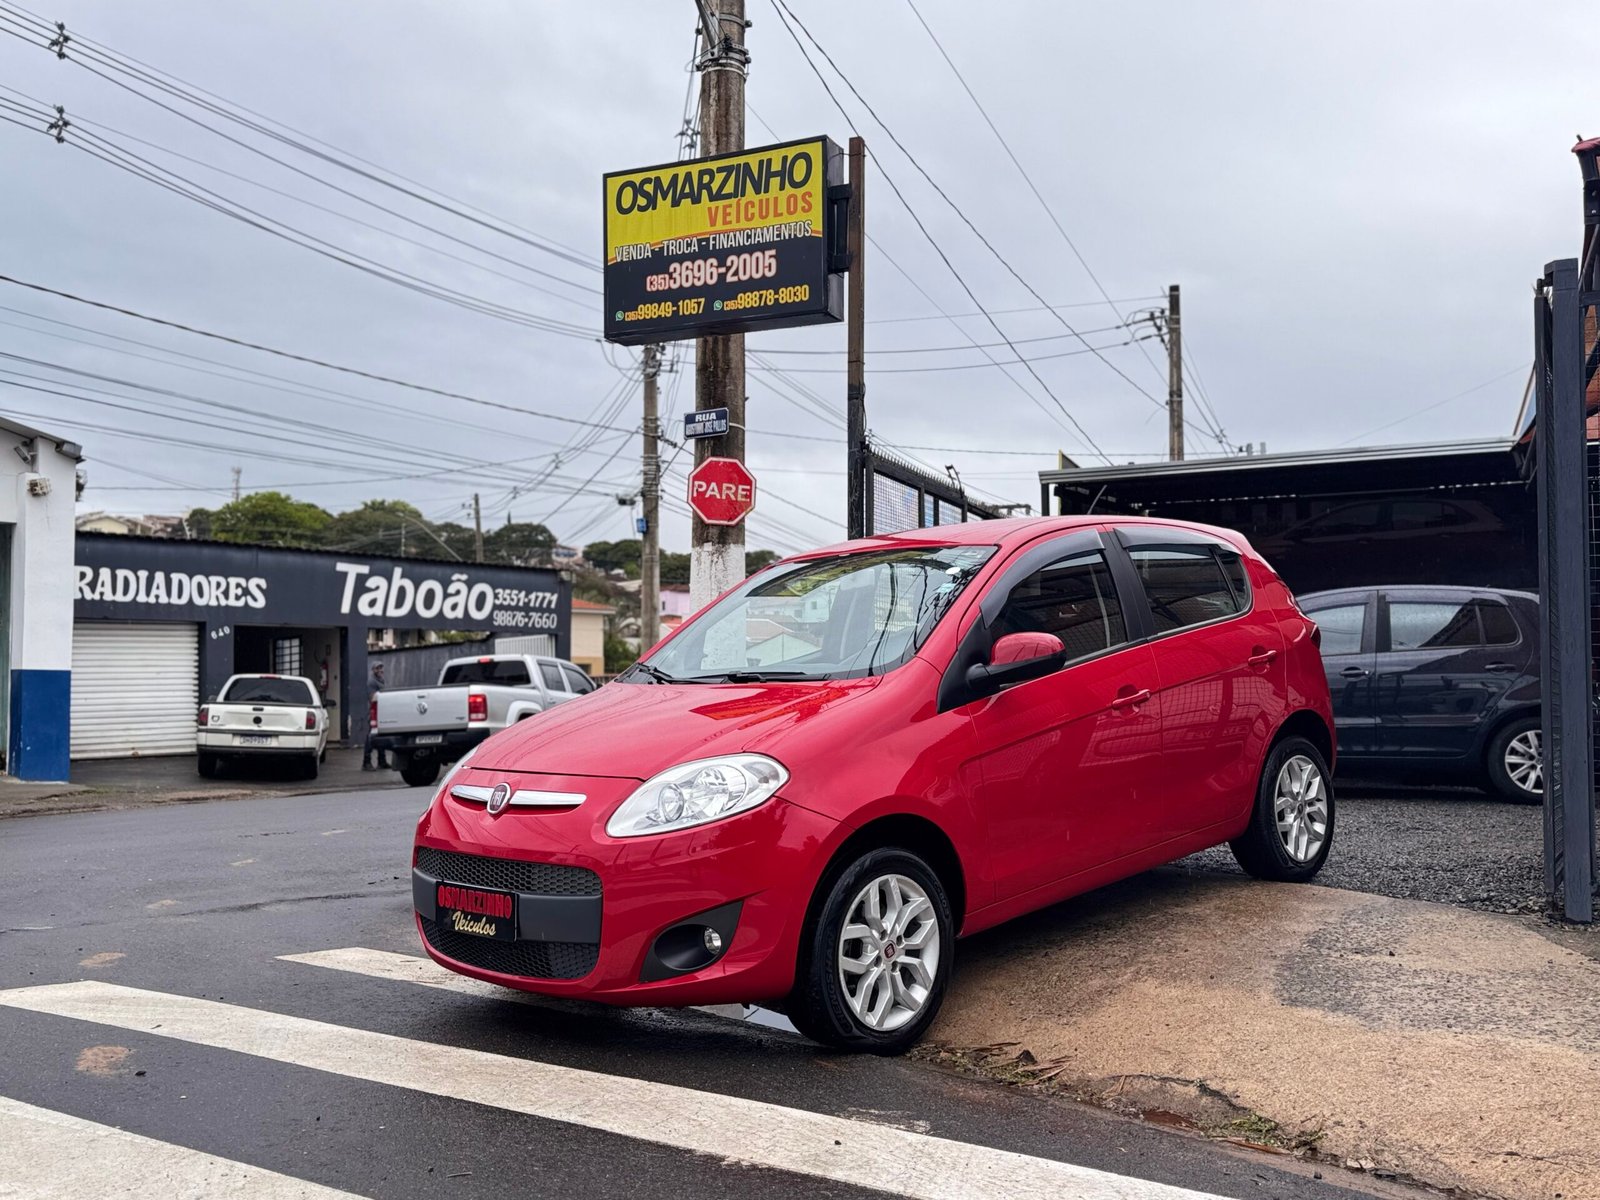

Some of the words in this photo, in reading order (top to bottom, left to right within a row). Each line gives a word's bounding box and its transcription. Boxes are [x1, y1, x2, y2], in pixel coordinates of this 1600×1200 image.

[615, 151, 813, 215] OSMARZINHO
[707, 191, 813, 227] VEÍCULOS
[615, 243, 652, 263] VENDA
[662, 236, 699, 255] TROCA
[709, 220, 813, 250] FINANCIAMENTOS
[695, 412, 717, 422] RUA
[693, 480, 751, 502] PARE
[74, 565, 268, 609] RADIADORES
[335, 561, 495, 621] Taboão
[210, 625, 231, 640] 640
[437, 884, 513, 920] OSMARZINHO
